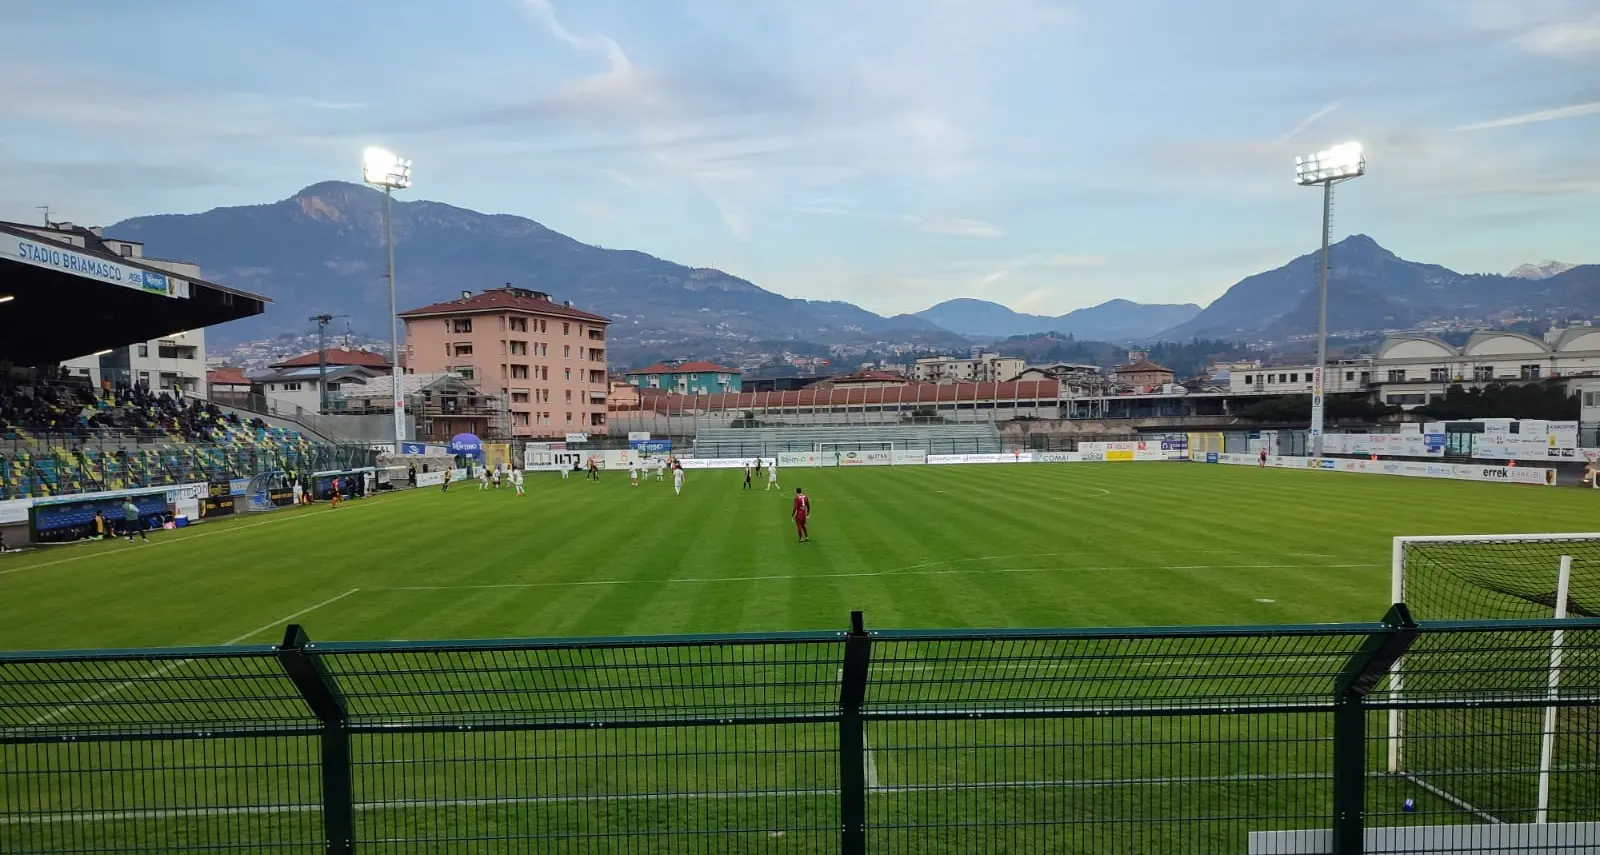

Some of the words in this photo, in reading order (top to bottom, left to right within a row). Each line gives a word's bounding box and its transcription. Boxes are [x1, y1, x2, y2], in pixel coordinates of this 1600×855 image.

[19, 242, 61, 266] STADIO
[63, 253, 122, 281] BRIAMASCO
[1483, 466, 1508, 478] errek
